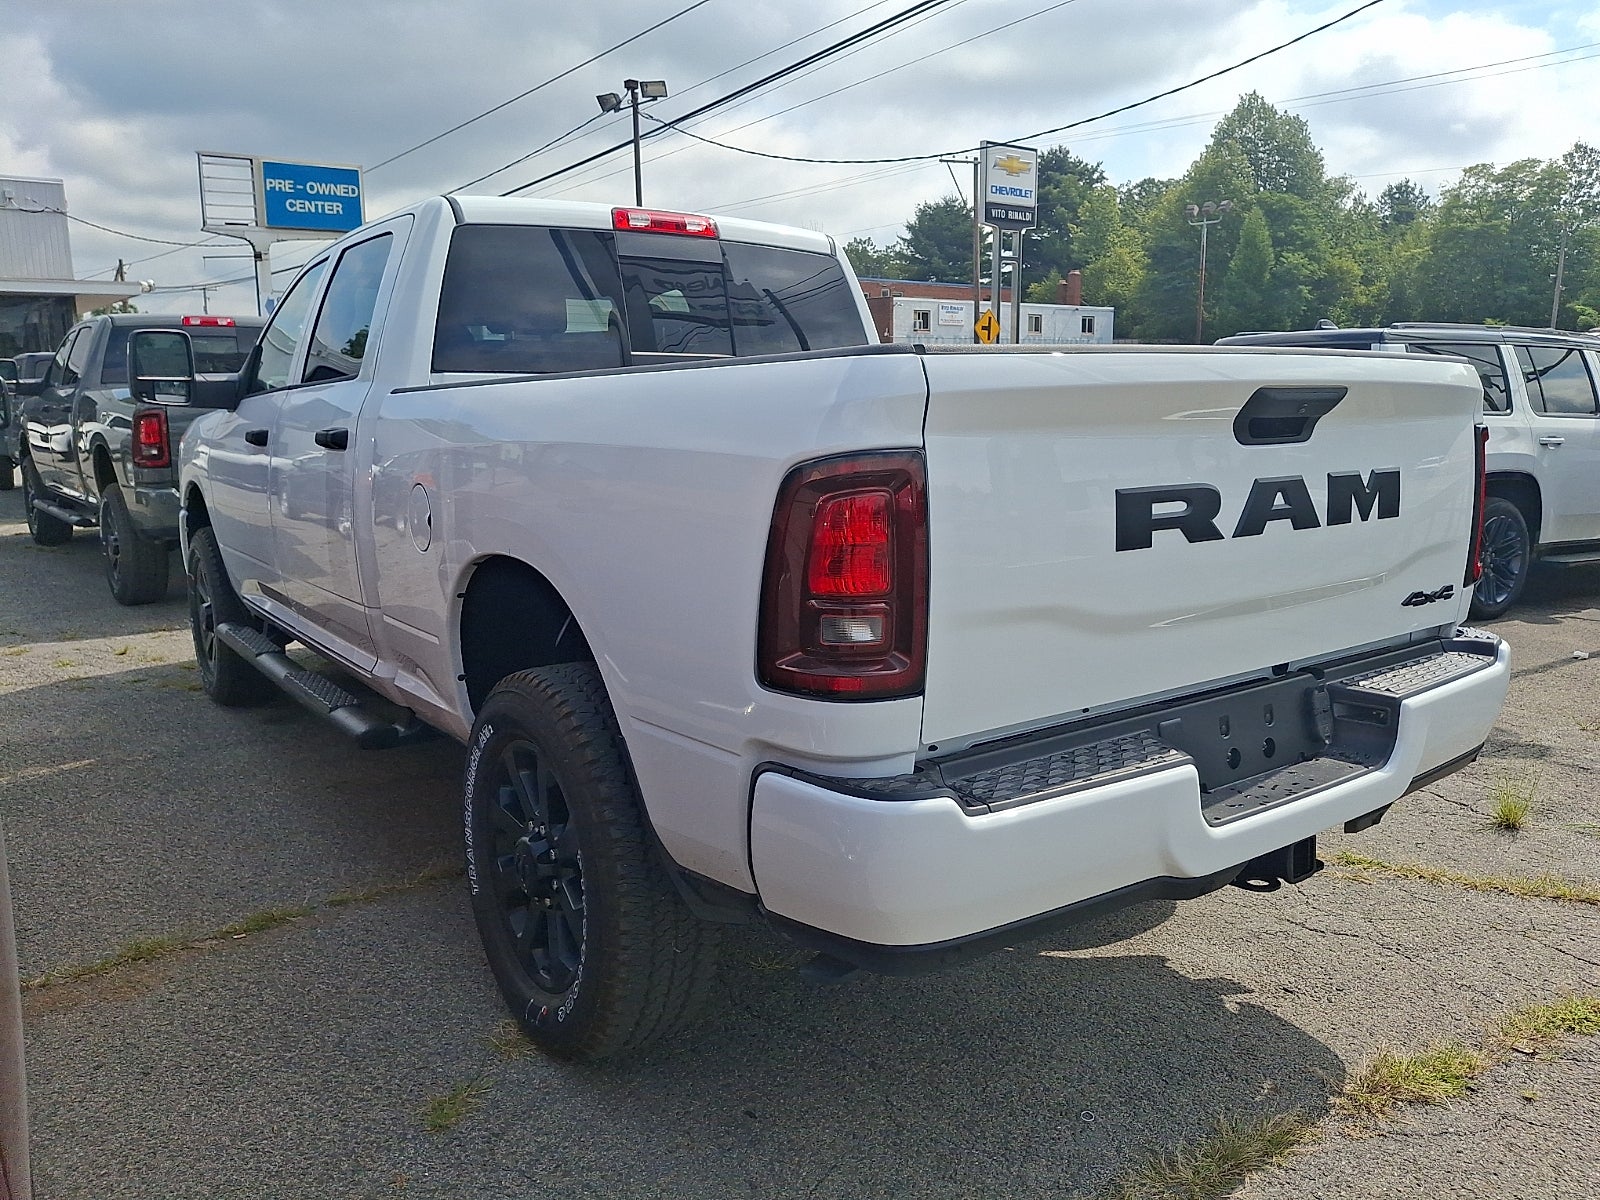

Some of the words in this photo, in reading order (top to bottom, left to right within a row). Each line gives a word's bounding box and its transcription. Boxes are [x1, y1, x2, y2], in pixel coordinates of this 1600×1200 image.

[990, 185, 1033, 199] CHEVROLET
[285, 200, 343, 215] CENTER
[991, 208, 1006, 219] VITO
[1007, 210, 1032, 222] RINALDI
[1115, 468, 1401, 552] RAM
